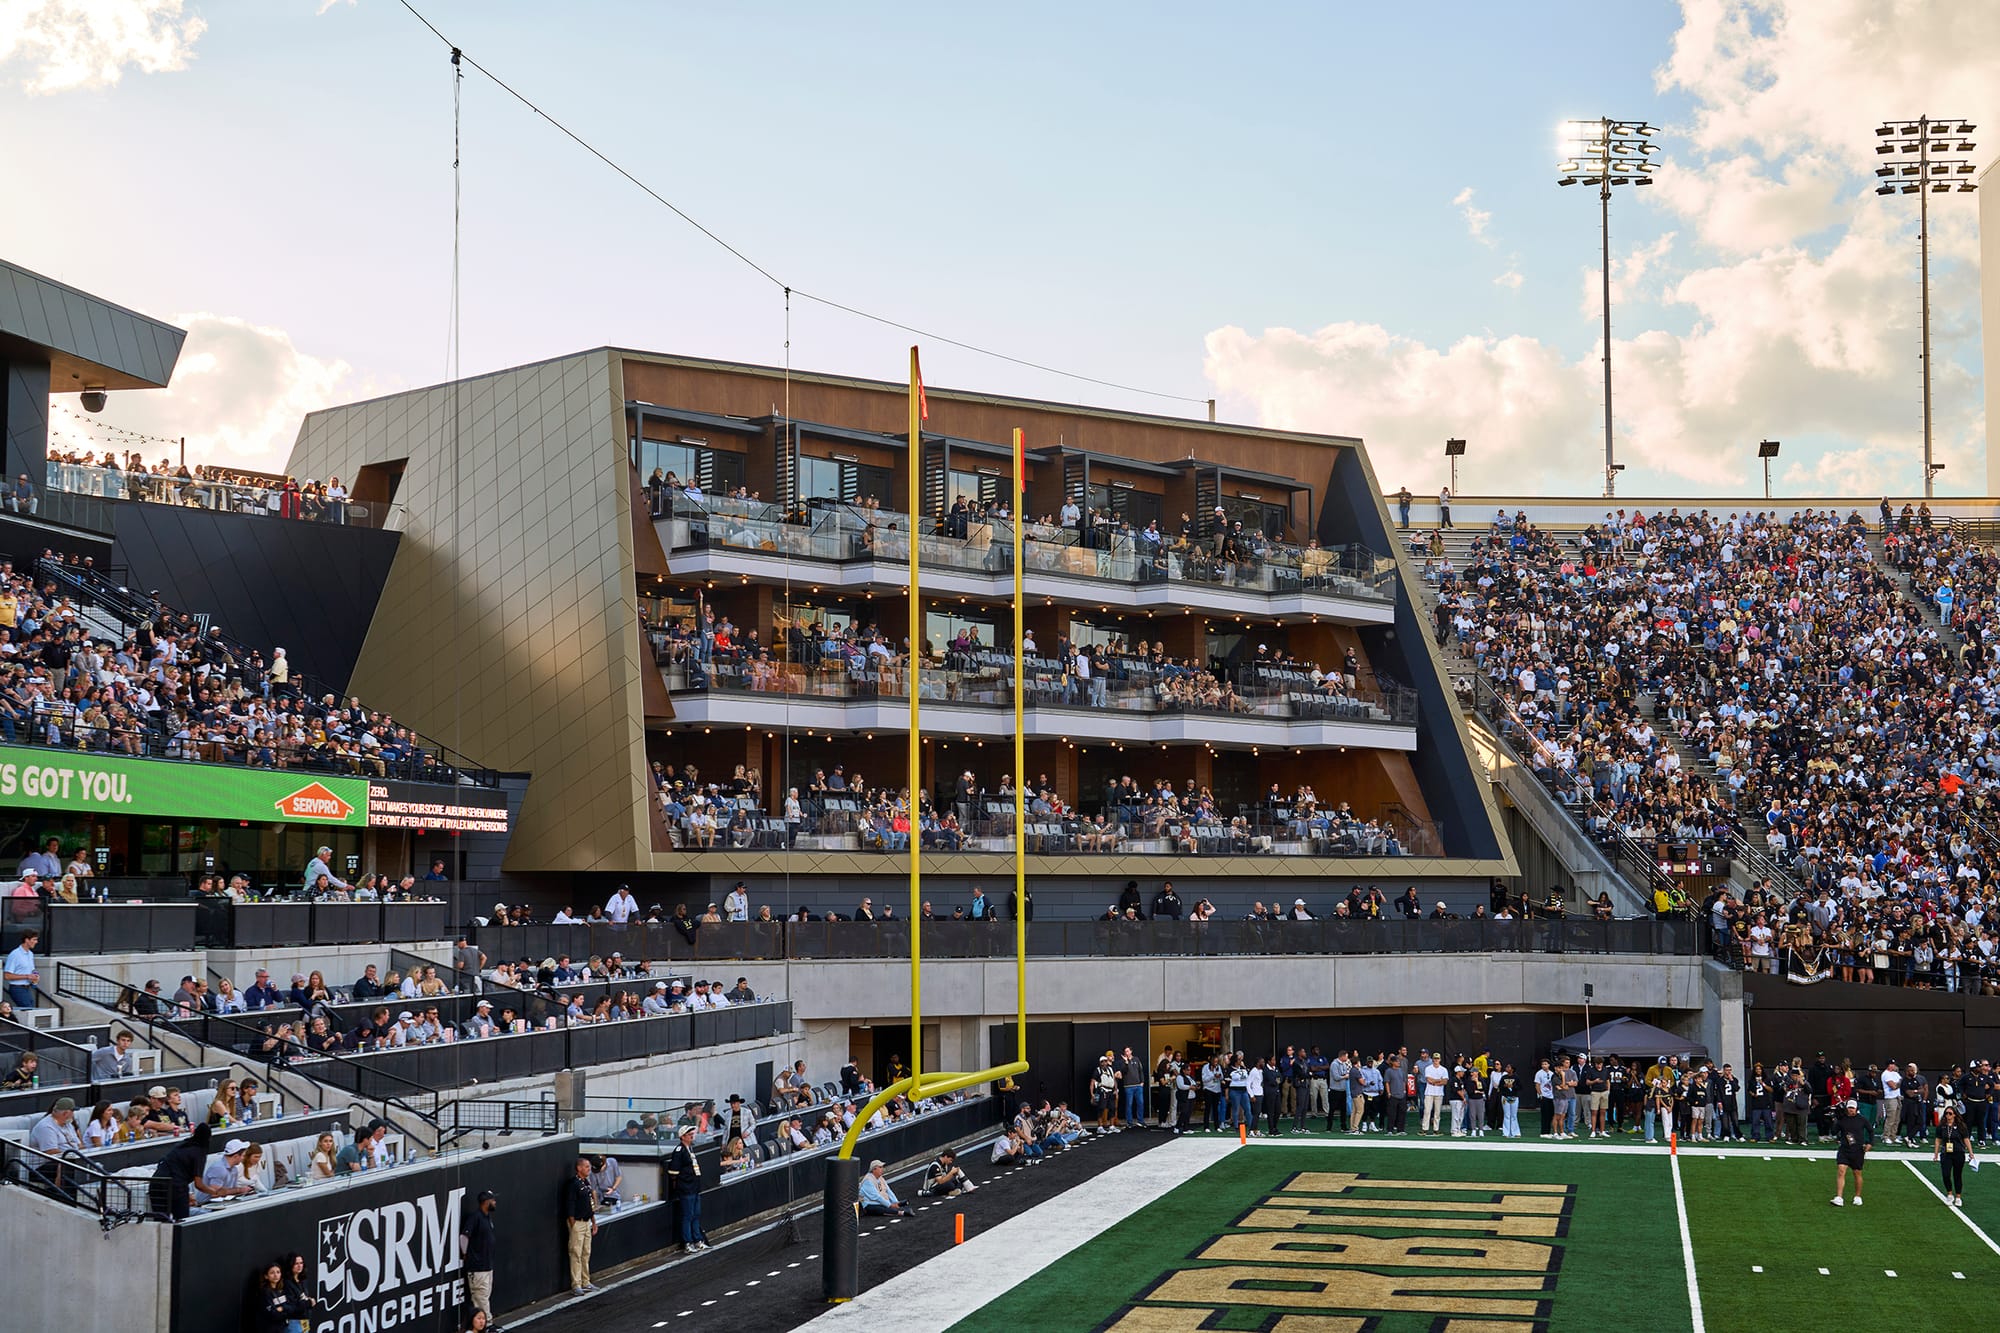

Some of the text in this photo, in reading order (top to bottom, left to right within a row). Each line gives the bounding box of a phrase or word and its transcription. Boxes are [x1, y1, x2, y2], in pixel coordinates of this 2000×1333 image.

[22, 765, 74, 799] GOT
[78, 770, 132, 803] YOU.
[370, 786, 389, 798] ZERO.
[370, 800, 387, 811] THAT
[387, 802, 408, 813] MAKES
[409, 803, 425, 814] YOUR
[370, 814, 382, 825] THE
[382, 815, 401, 826] POINT
[401, 816, 419, 827] AFTER
[419, 817, 445, 828] ATTEMPT
[1706, 864, 1712, 872] G
[1725, 1084, 1732, 1095] 2
[1756, 1084, 1764, 1096] 2
[346, 1187, 466, 1303] SRM
